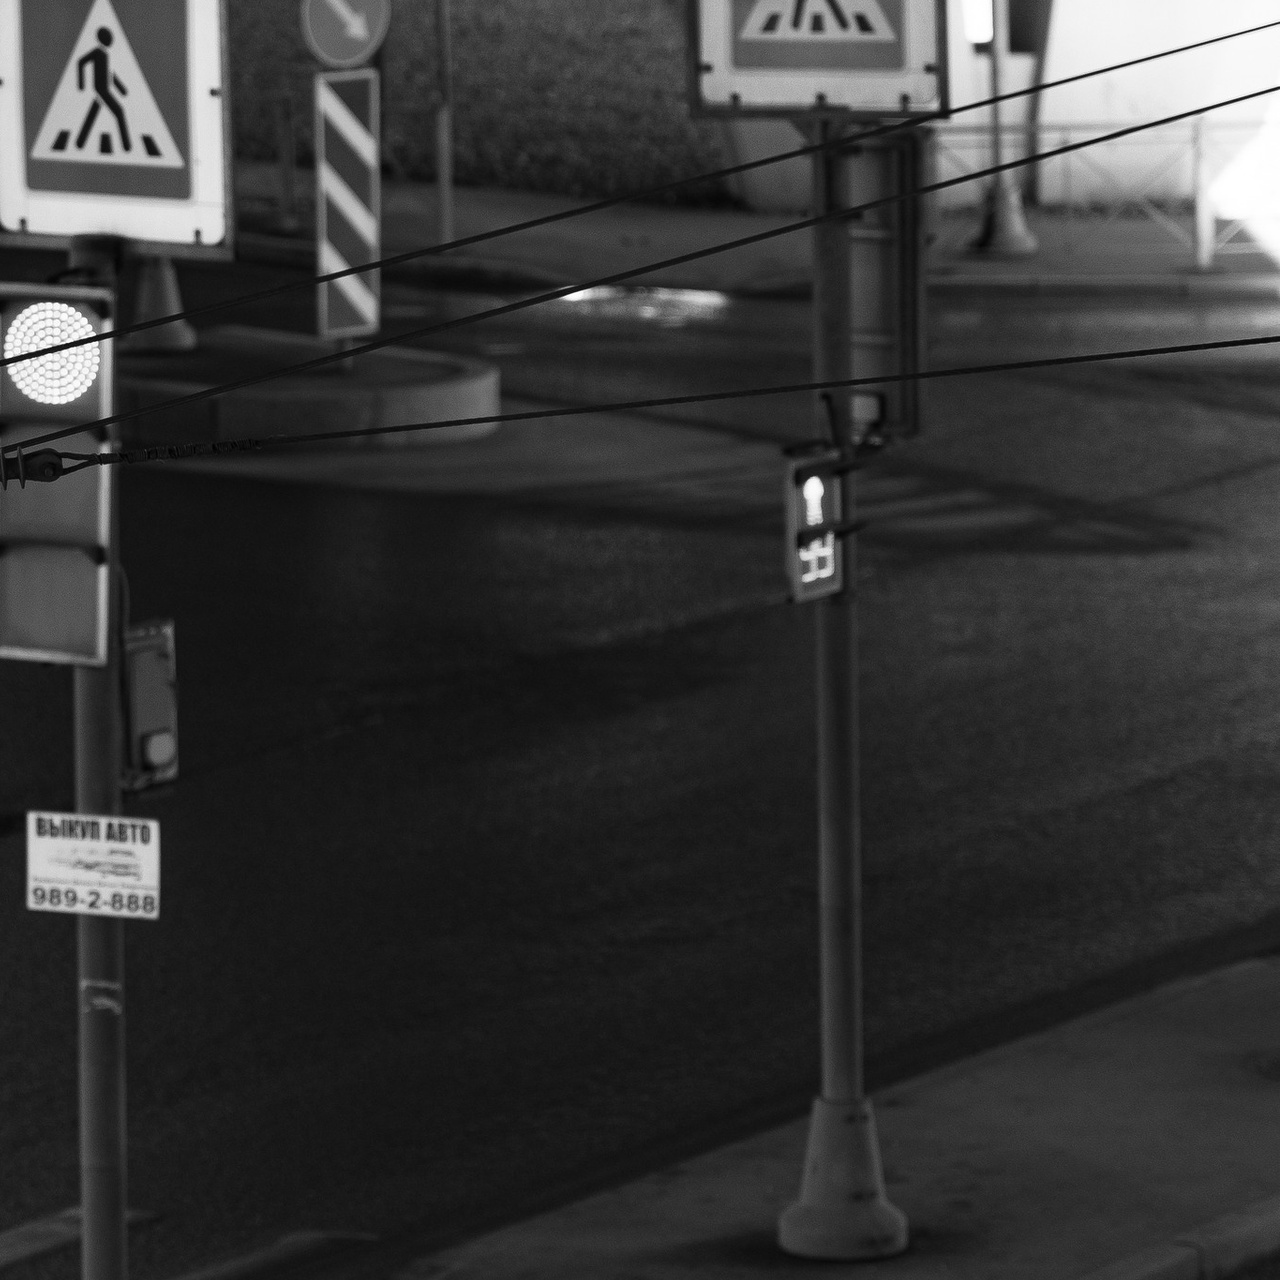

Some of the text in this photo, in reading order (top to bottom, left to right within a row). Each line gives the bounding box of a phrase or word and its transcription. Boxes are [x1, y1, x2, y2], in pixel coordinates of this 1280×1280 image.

[36, 817, 151, 845] ВЫКУП АВТО
[33, 887, 156, 914] 989-2-888
